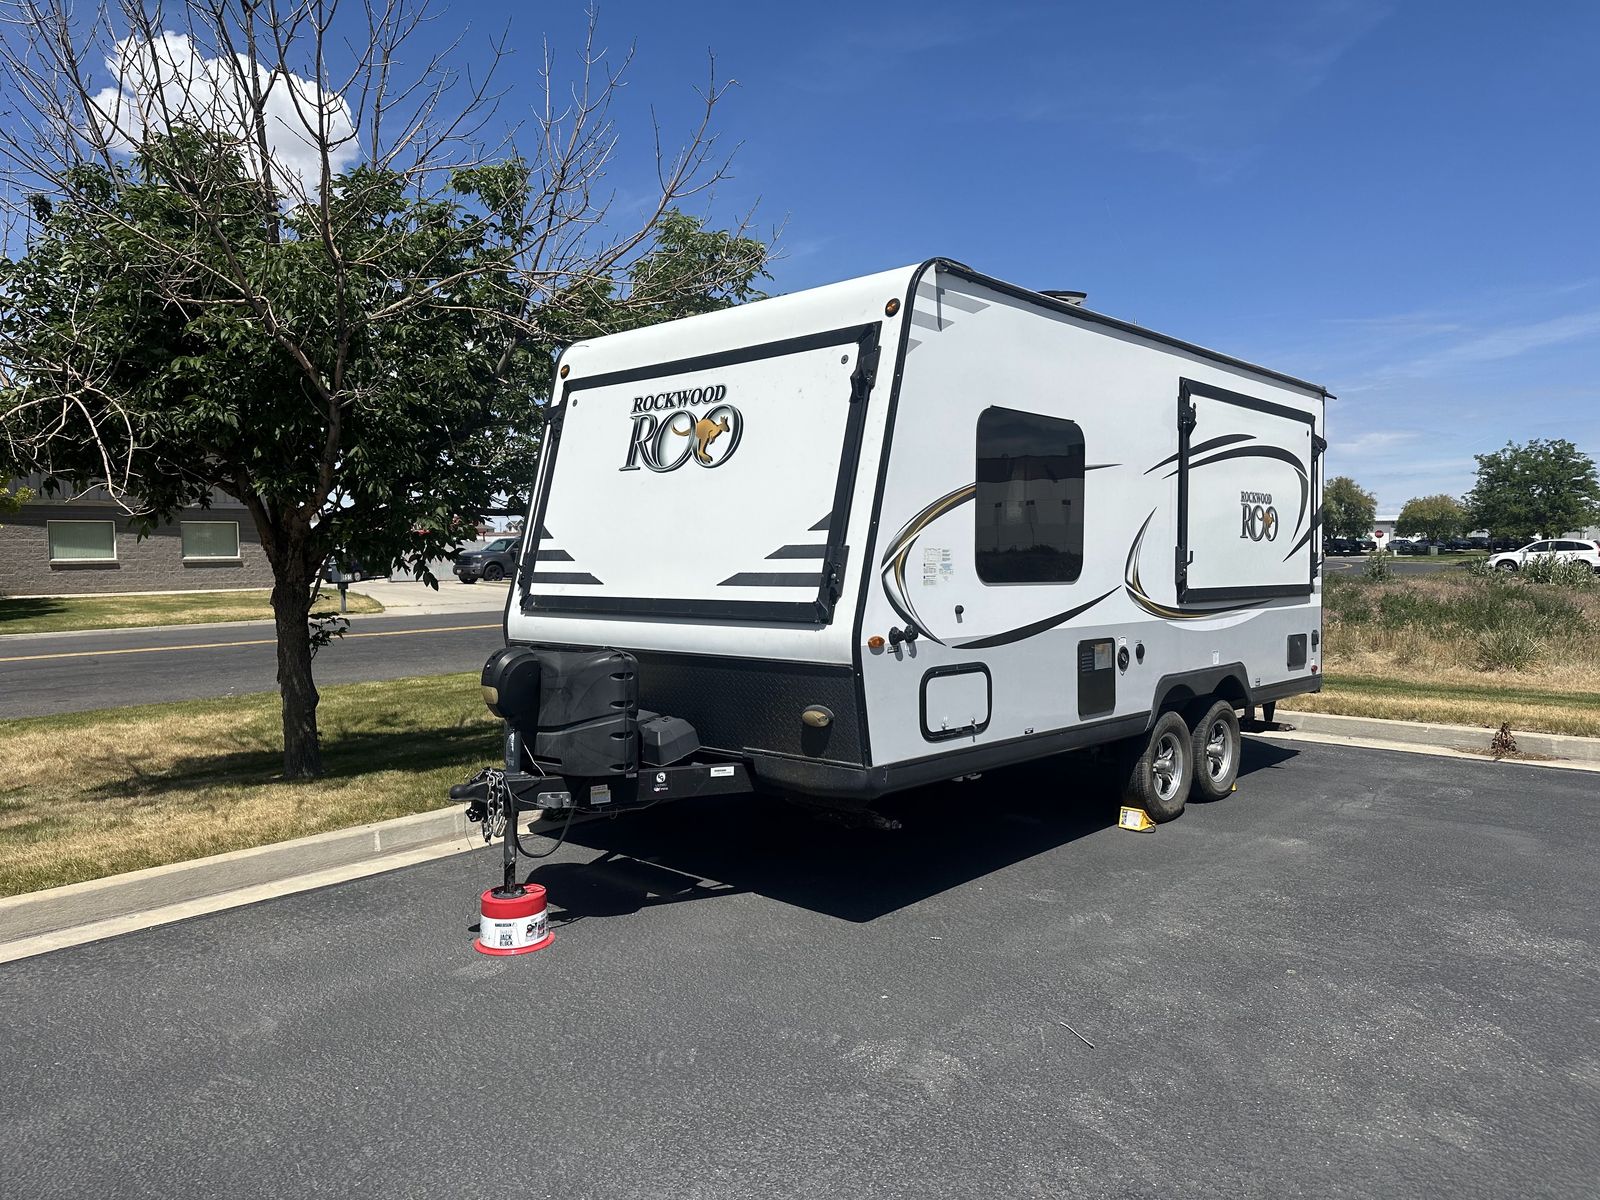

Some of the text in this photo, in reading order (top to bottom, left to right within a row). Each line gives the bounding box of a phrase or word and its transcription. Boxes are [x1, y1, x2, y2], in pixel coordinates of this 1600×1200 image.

[632, 384, 727, 414] ROCKWOOD
[618, 404, 744, 474] ROO
[1240, 491, 1272, 505] ROCKWOOD
[1240, 503, 1278, 542] ROO
